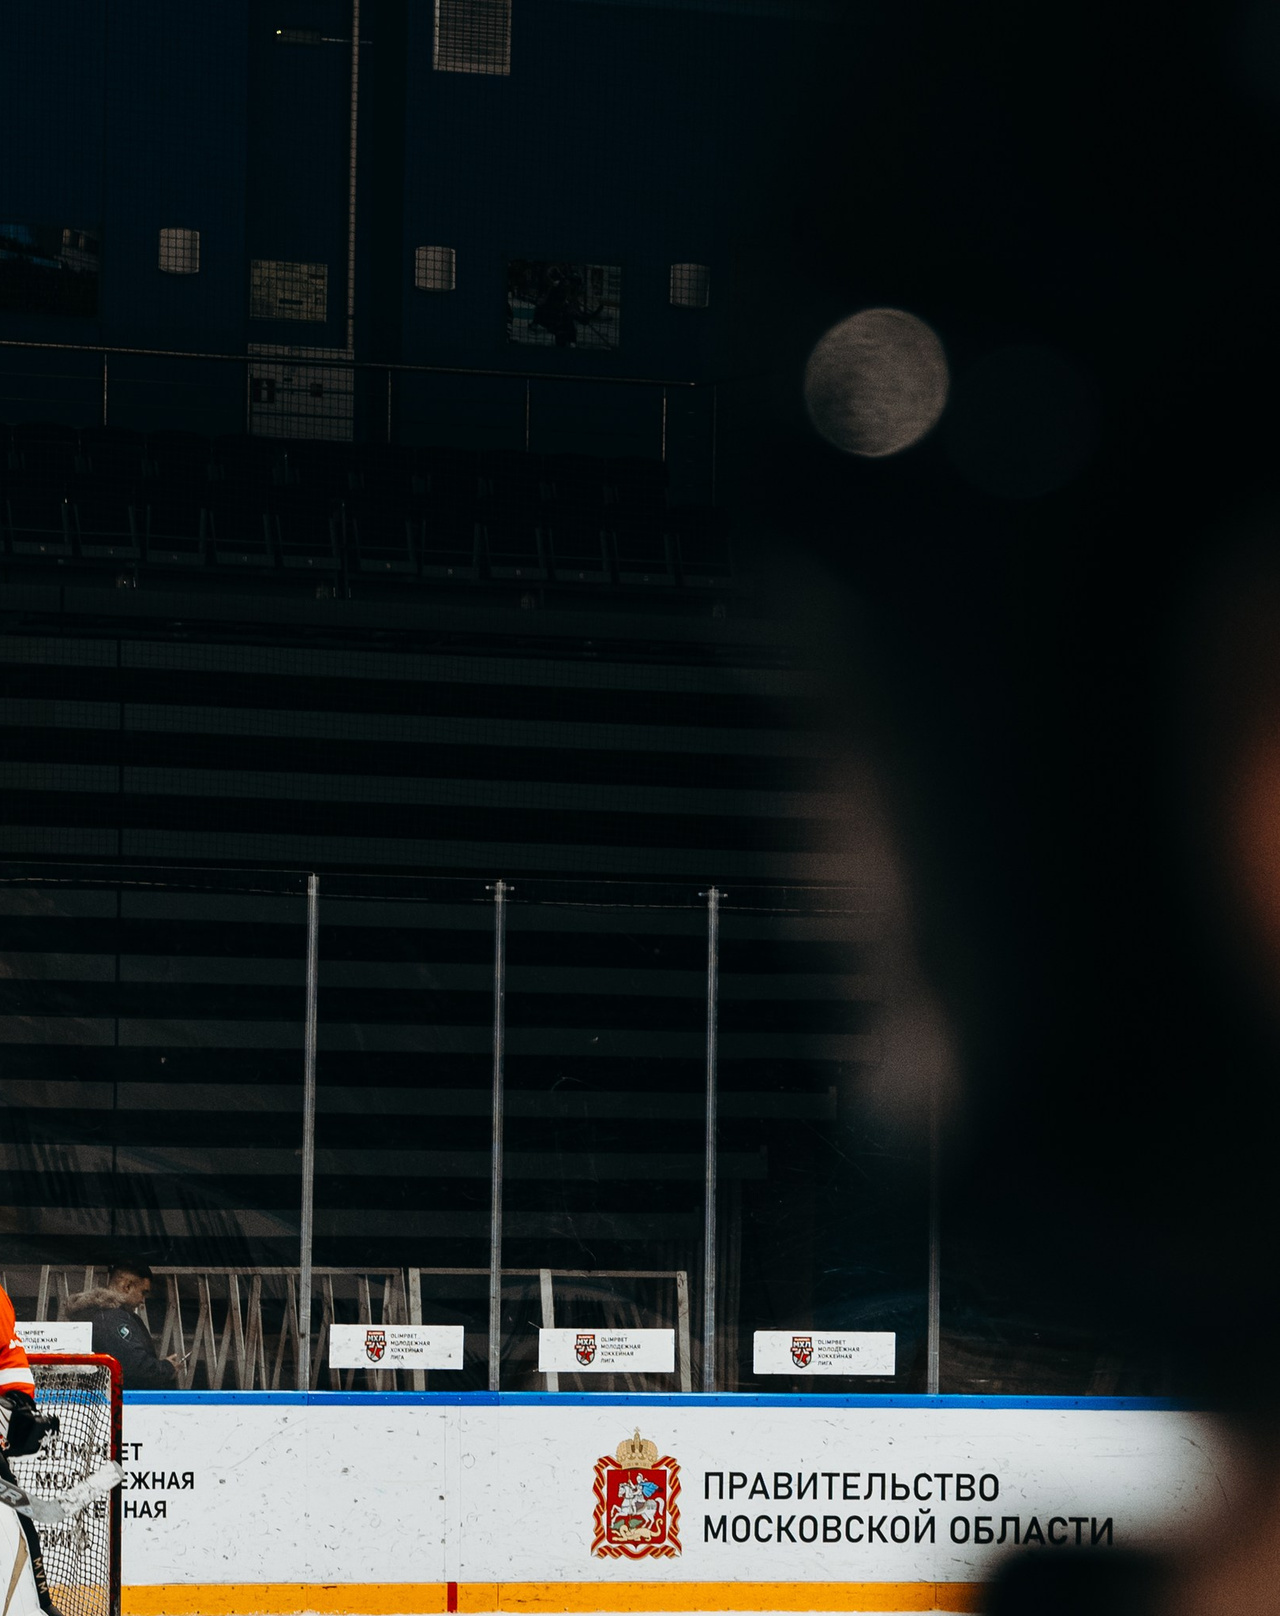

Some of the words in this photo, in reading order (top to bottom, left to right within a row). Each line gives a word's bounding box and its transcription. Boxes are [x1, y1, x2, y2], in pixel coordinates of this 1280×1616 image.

[35, 1471, 195, 1490] МОЛЕЖНАЯ
[704, 1471, 1000, 1502] ПРАВИТЕЛЬСТВО
[704, 1507, 936, 1545] МОСКОВСКОЙ
[950, 1515, 1114, 1547] ОБЛАСТИ
[33, 1557, 48, 1594] MVM
